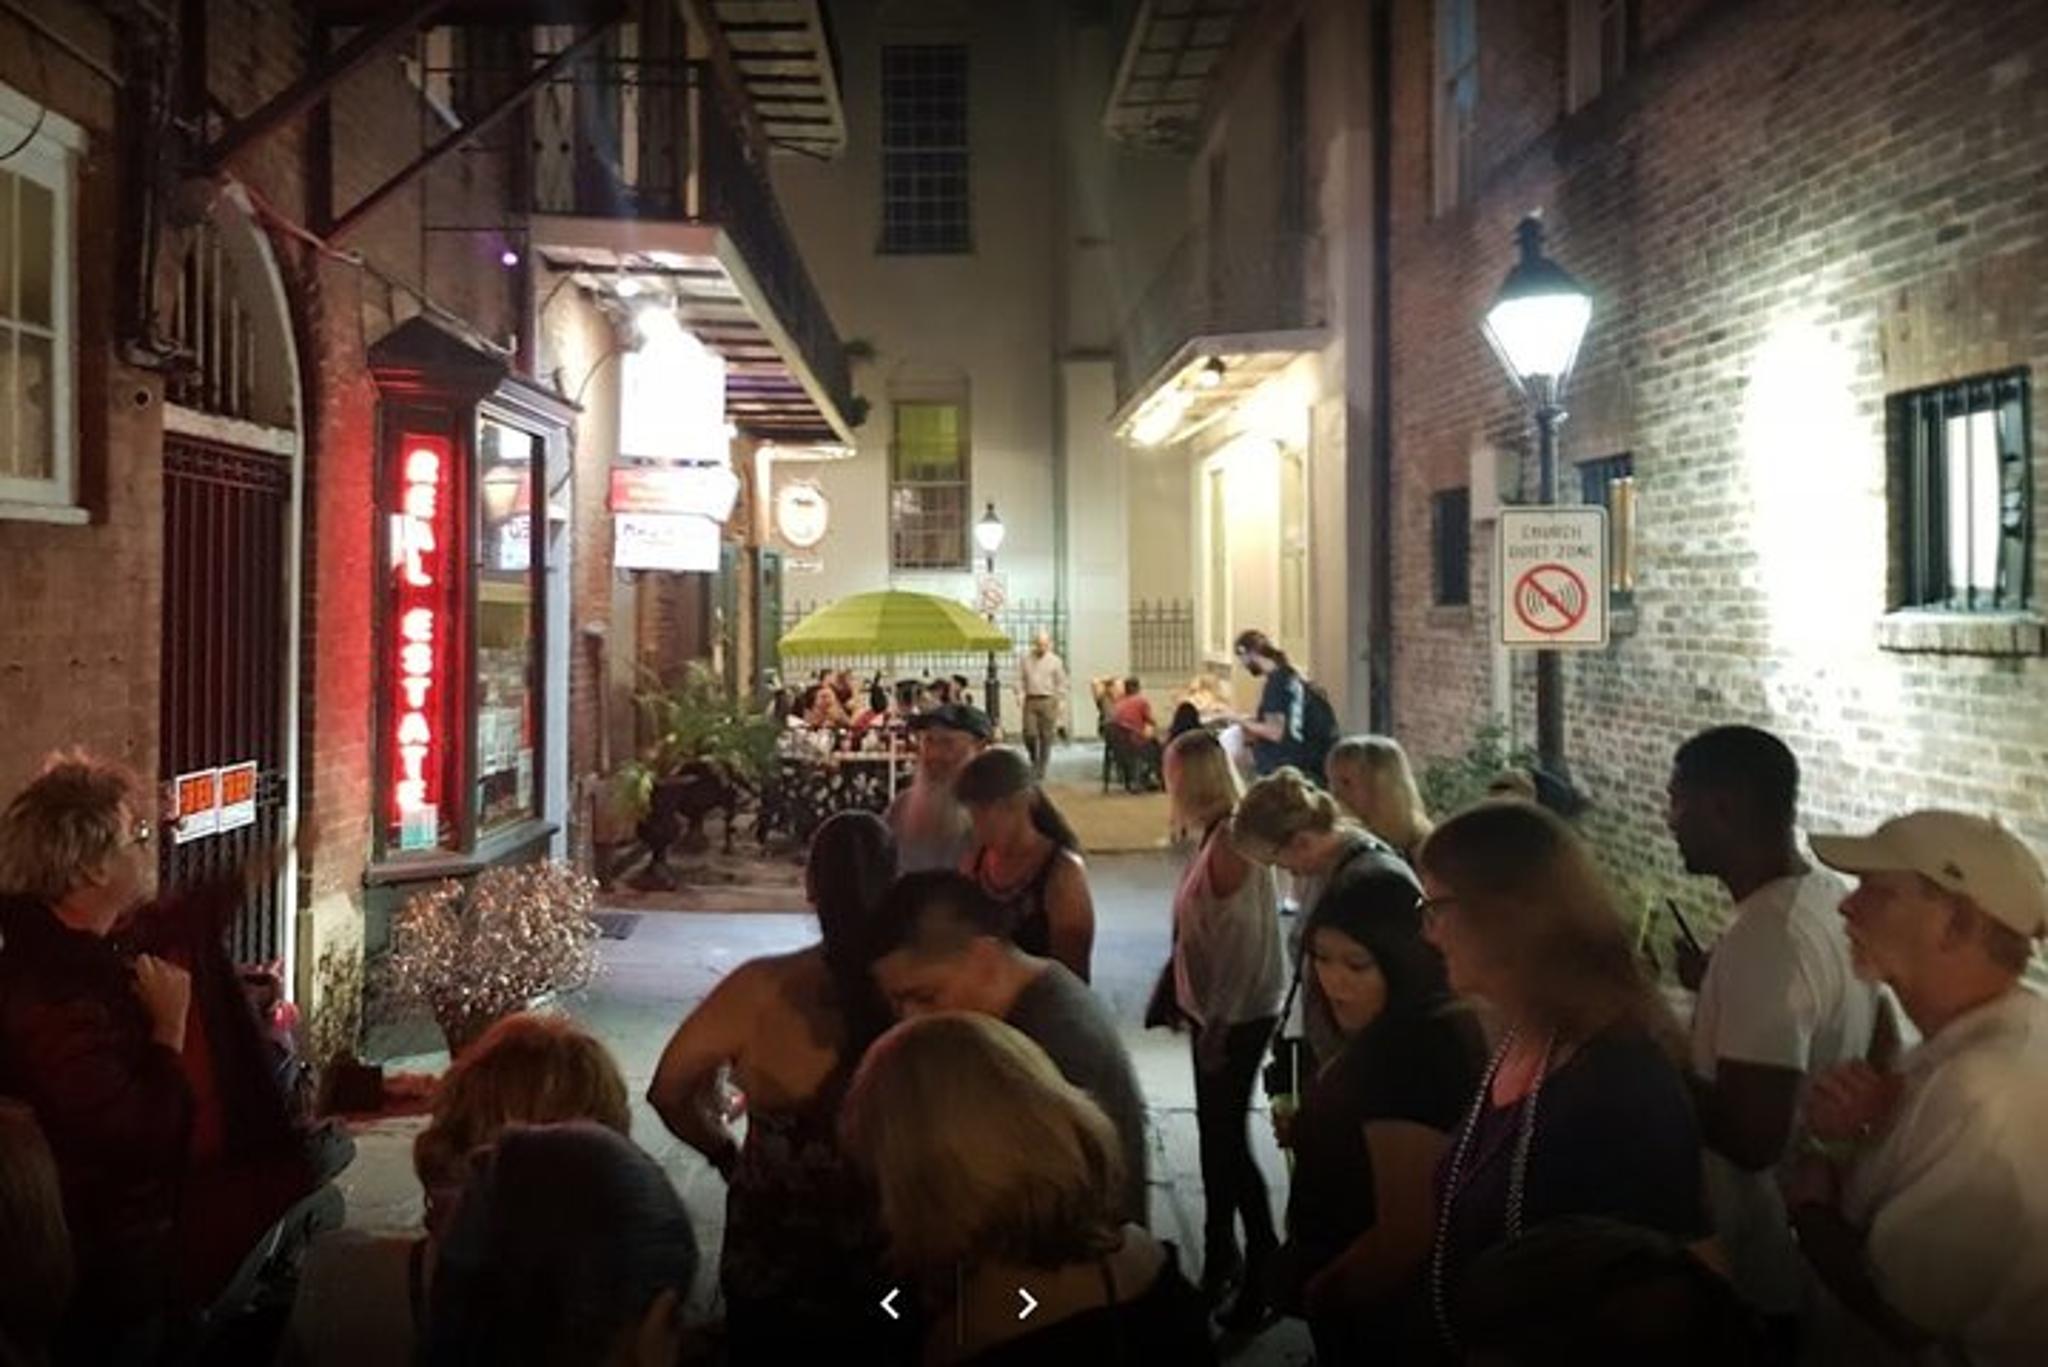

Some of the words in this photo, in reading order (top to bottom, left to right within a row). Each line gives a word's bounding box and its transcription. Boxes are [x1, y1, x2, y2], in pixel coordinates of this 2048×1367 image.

[404, 448, 440, 587] REAL
[1508, 544, 1549, 559] QUIET
[1555, 543, 1595, 559] ZONE
[1520, 524, 1582, 540] CHURCH
[396, 608, 434, 812] ESTATE
